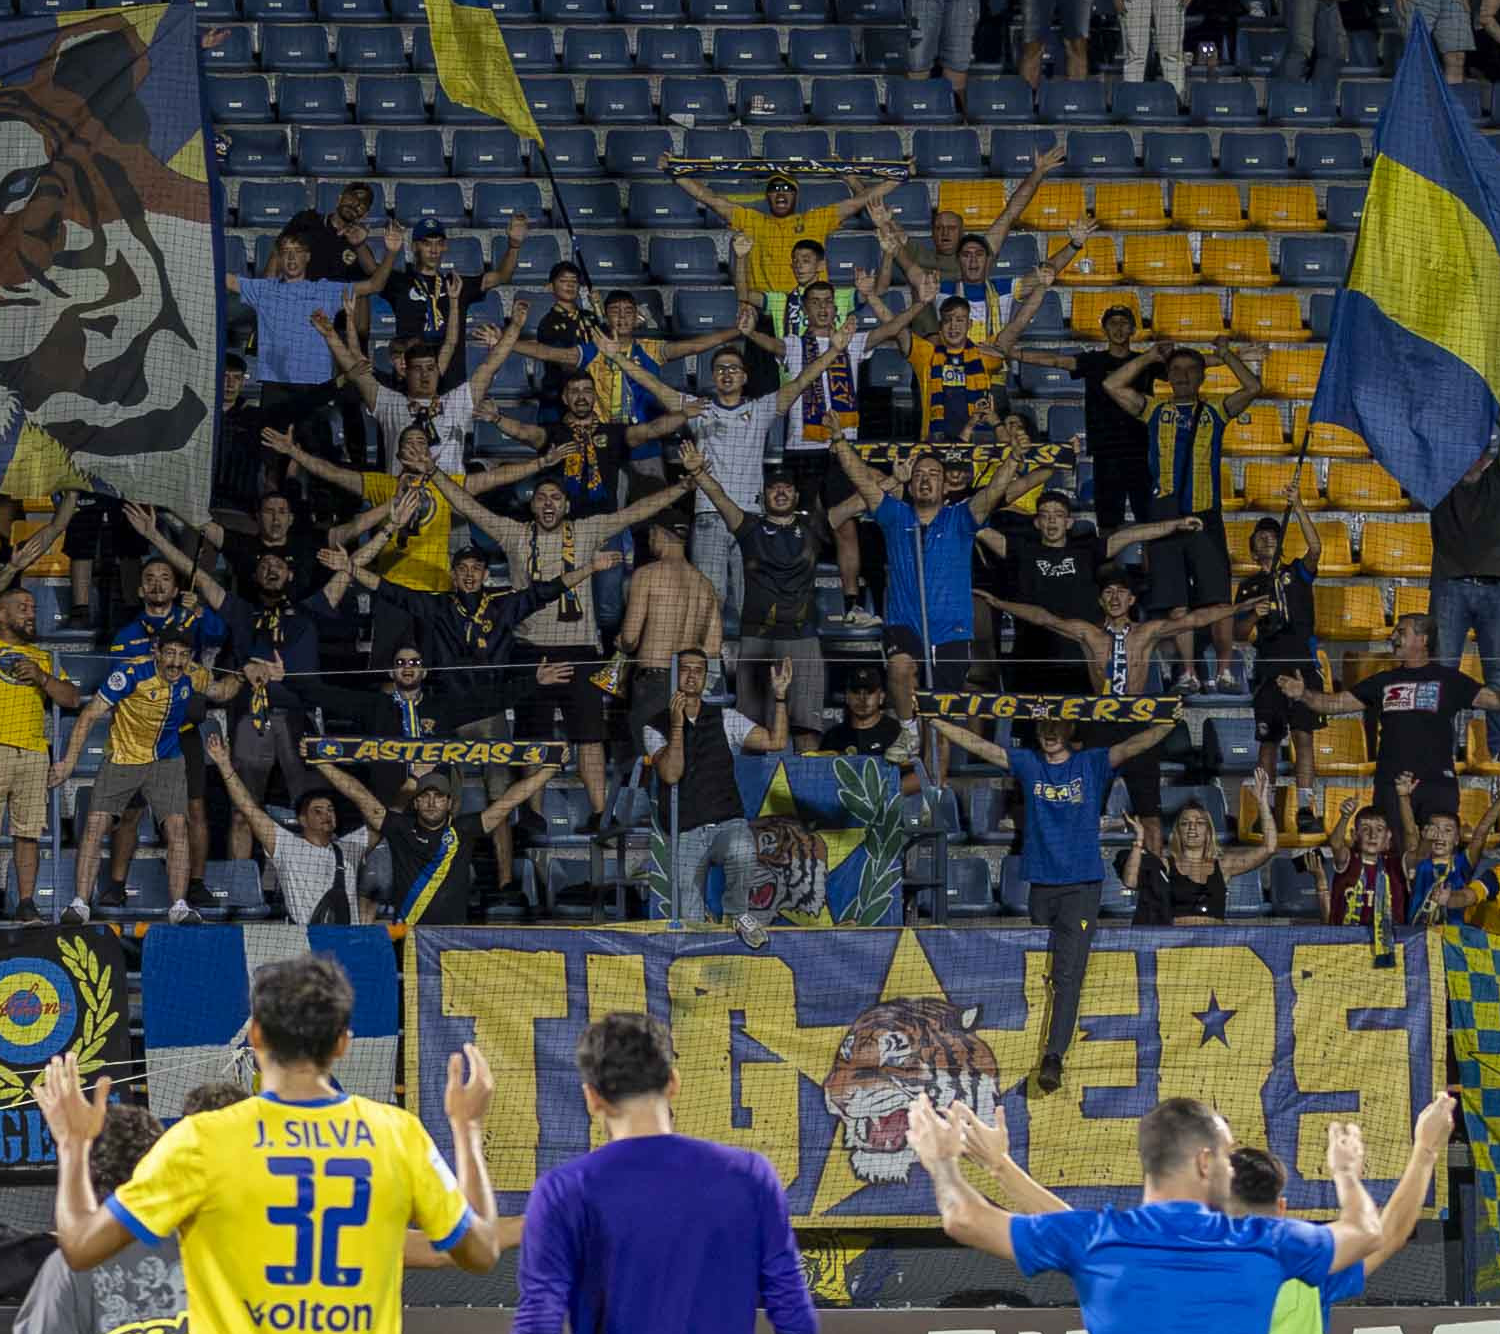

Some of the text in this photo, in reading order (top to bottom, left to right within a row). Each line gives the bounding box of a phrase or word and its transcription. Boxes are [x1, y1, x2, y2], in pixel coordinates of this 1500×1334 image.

[934, 693, 1159, 722] TIGERS
[354, 740, 513, 765] ASTERAS
[253, 1119, 375, 1148] J. SILVA
[264, 1156, 373, 1287] 32
[243, 1299, 373, 1332] volton
